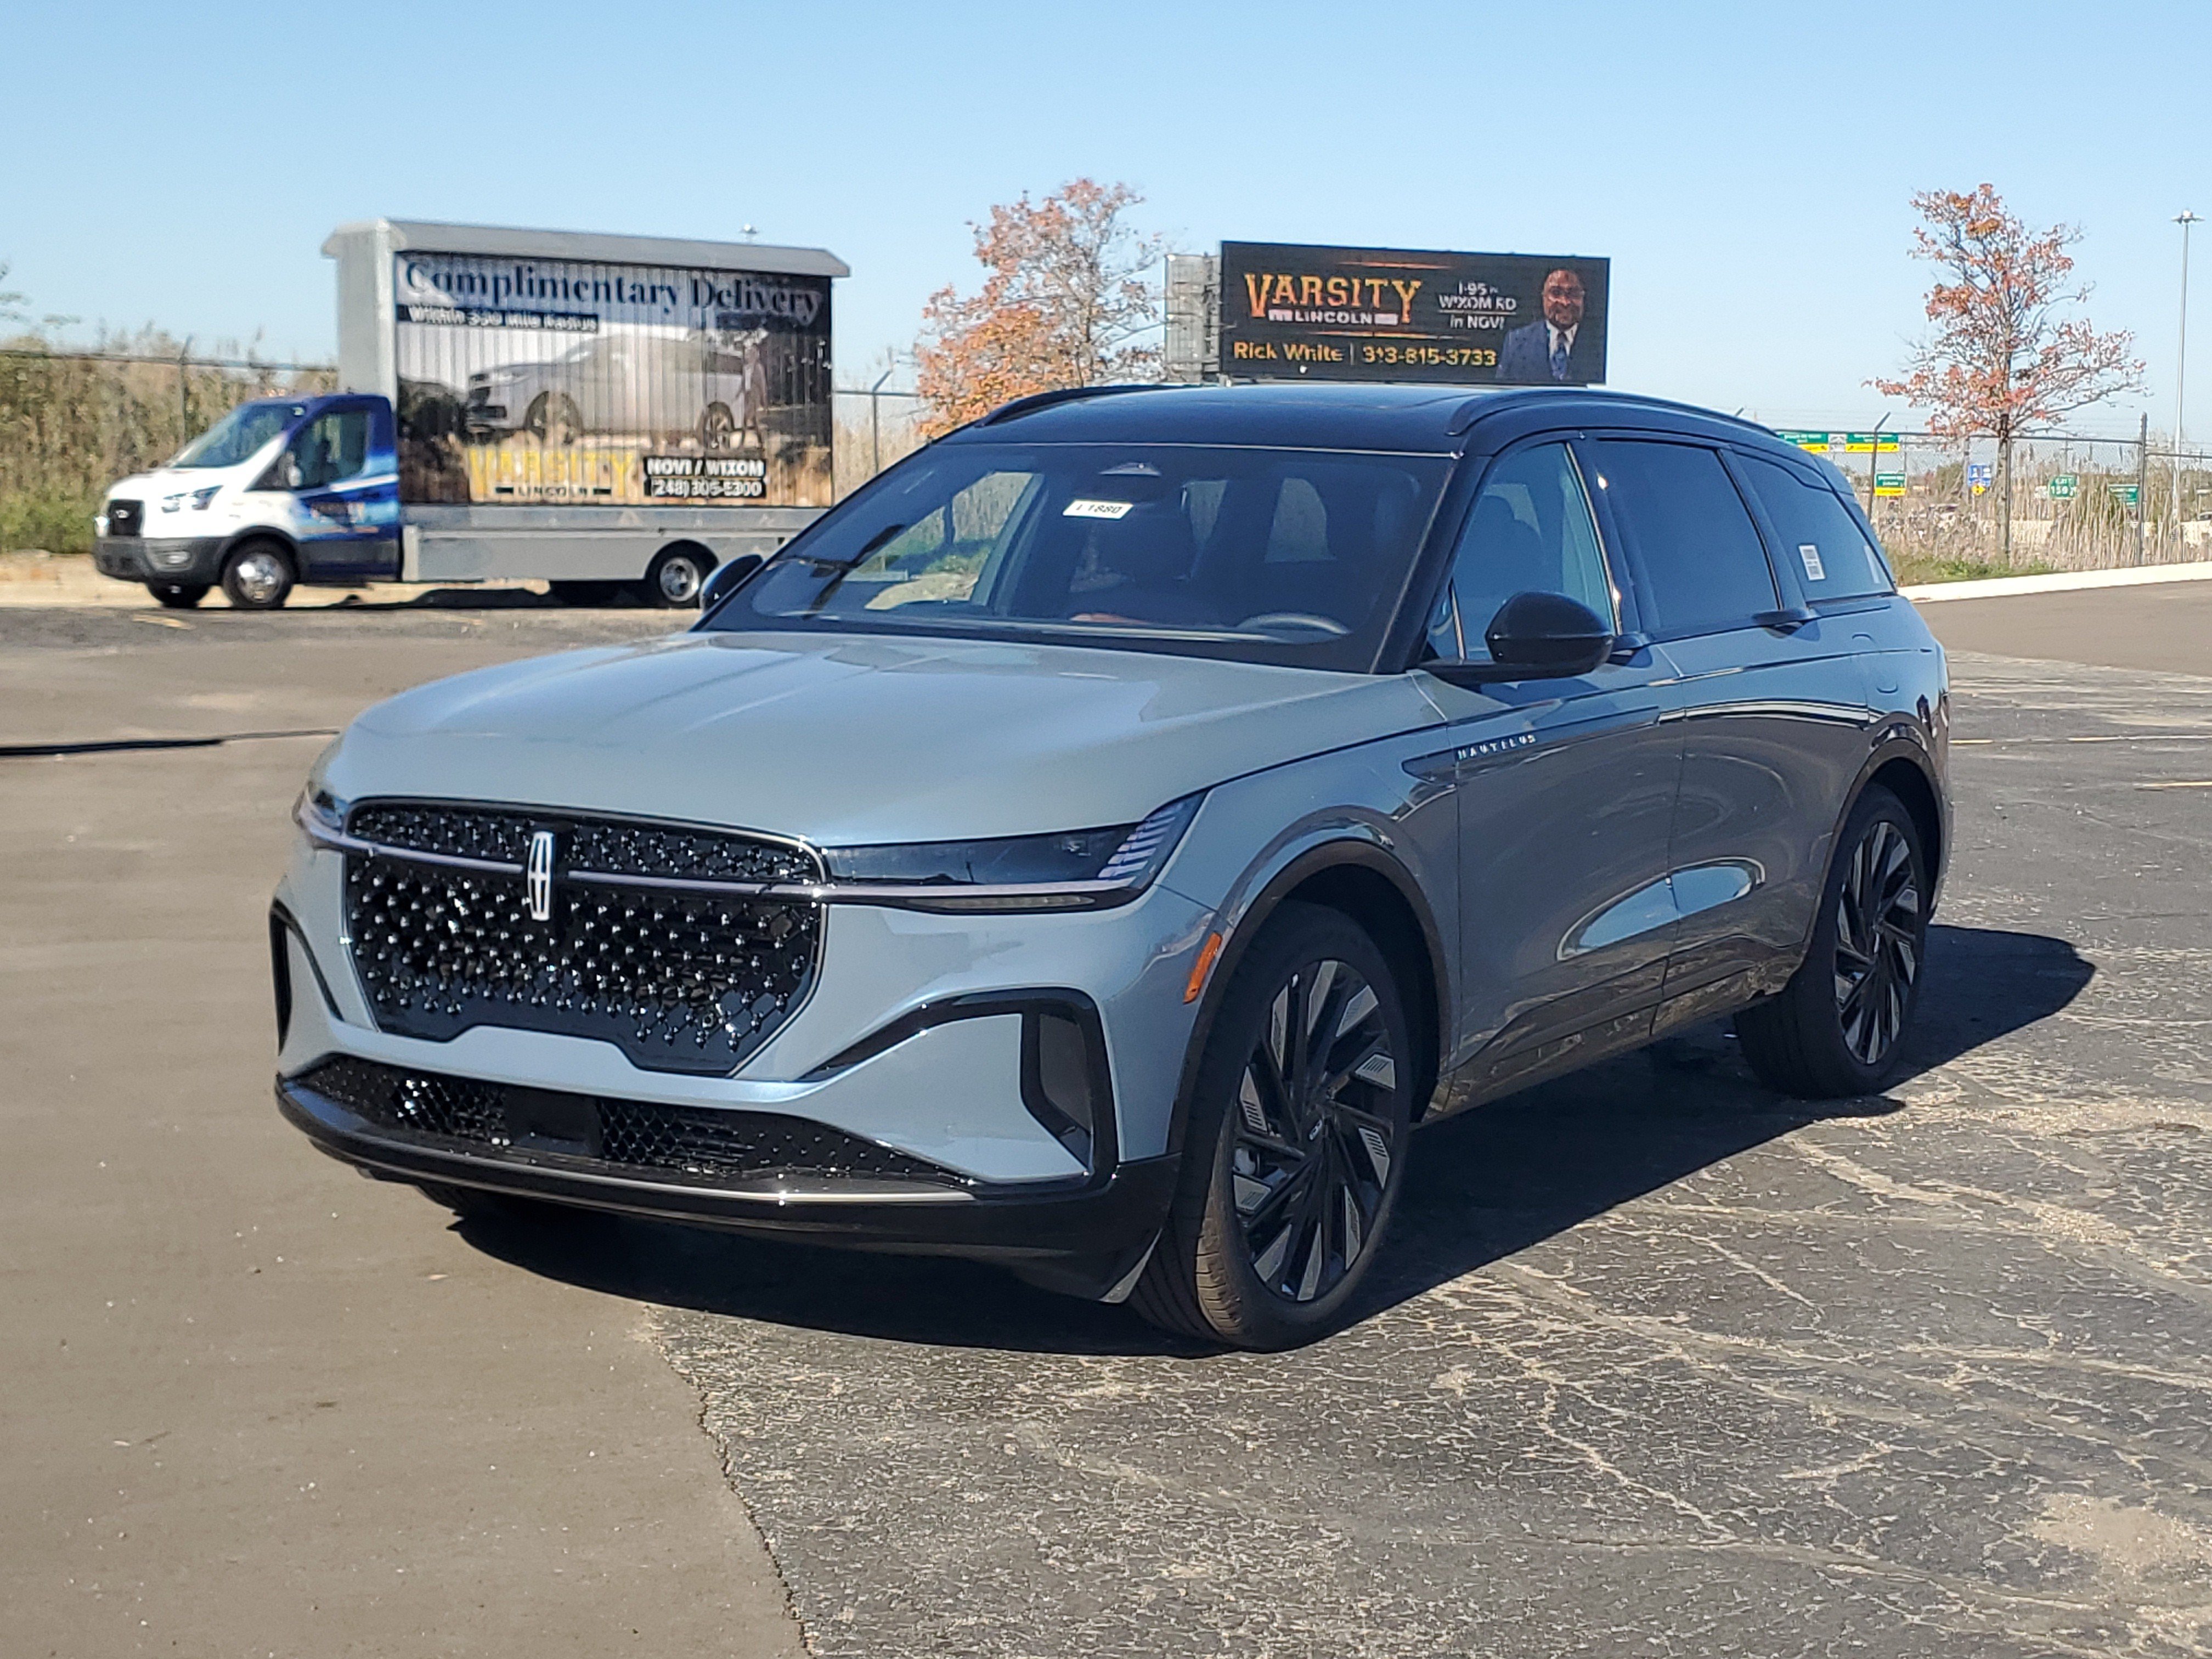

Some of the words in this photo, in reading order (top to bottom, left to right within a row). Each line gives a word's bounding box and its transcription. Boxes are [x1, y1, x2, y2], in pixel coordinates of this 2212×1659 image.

[407, 261, 677, 314] Complimentary
[691, 278, 820, 321] Delivery
[1244, 273, 1423, 324] VARSITY
[1438, 294, 1492, 309] WIXOM
[1495, 296, 1517, 311] RD
[1294, 309, 1373, 324] LINCOLN
[1449, 314, 1464, 329] in
[1234, 340, 1278, 360] Rick
[1282, 342, 1344, 362] White
[1362, 345, 1497, 366] 313-815-3733
[469, 448, 634, 497] VARSITY
[647, 458, 692, 476] NOVI
[706, 459, 764, 477] WIXOM
[1457, 734, 1536, 760] NAUTILUS
